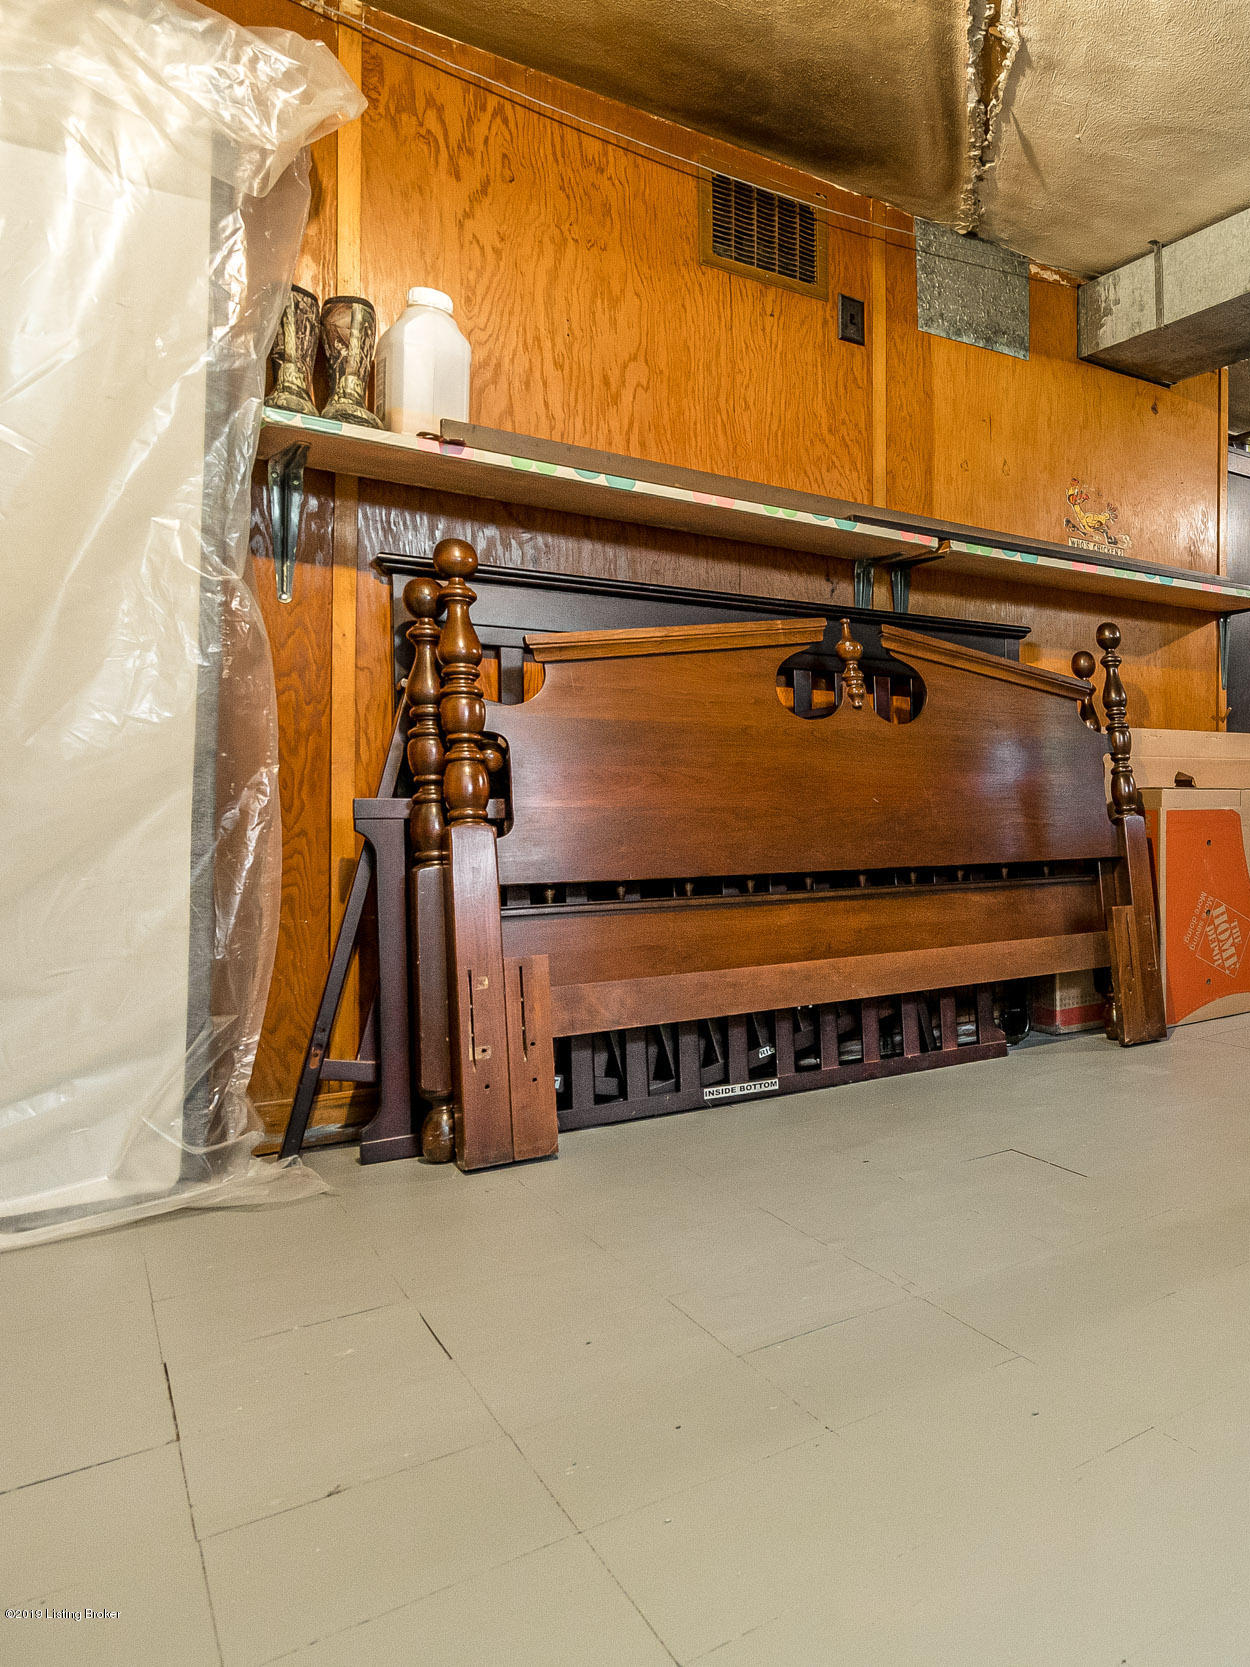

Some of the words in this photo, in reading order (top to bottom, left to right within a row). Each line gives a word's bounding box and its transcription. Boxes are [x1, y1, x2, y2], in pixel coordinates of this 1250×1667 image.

[1207, 925, 1223, 967] DEPOT
[1213, 904, 1240, 974] HOME
[1231, 918, 1242, 946] THE
[704, 1086, 737, 1098] INSIDE
[739, 1080, 778, 1092] BOTTOM
